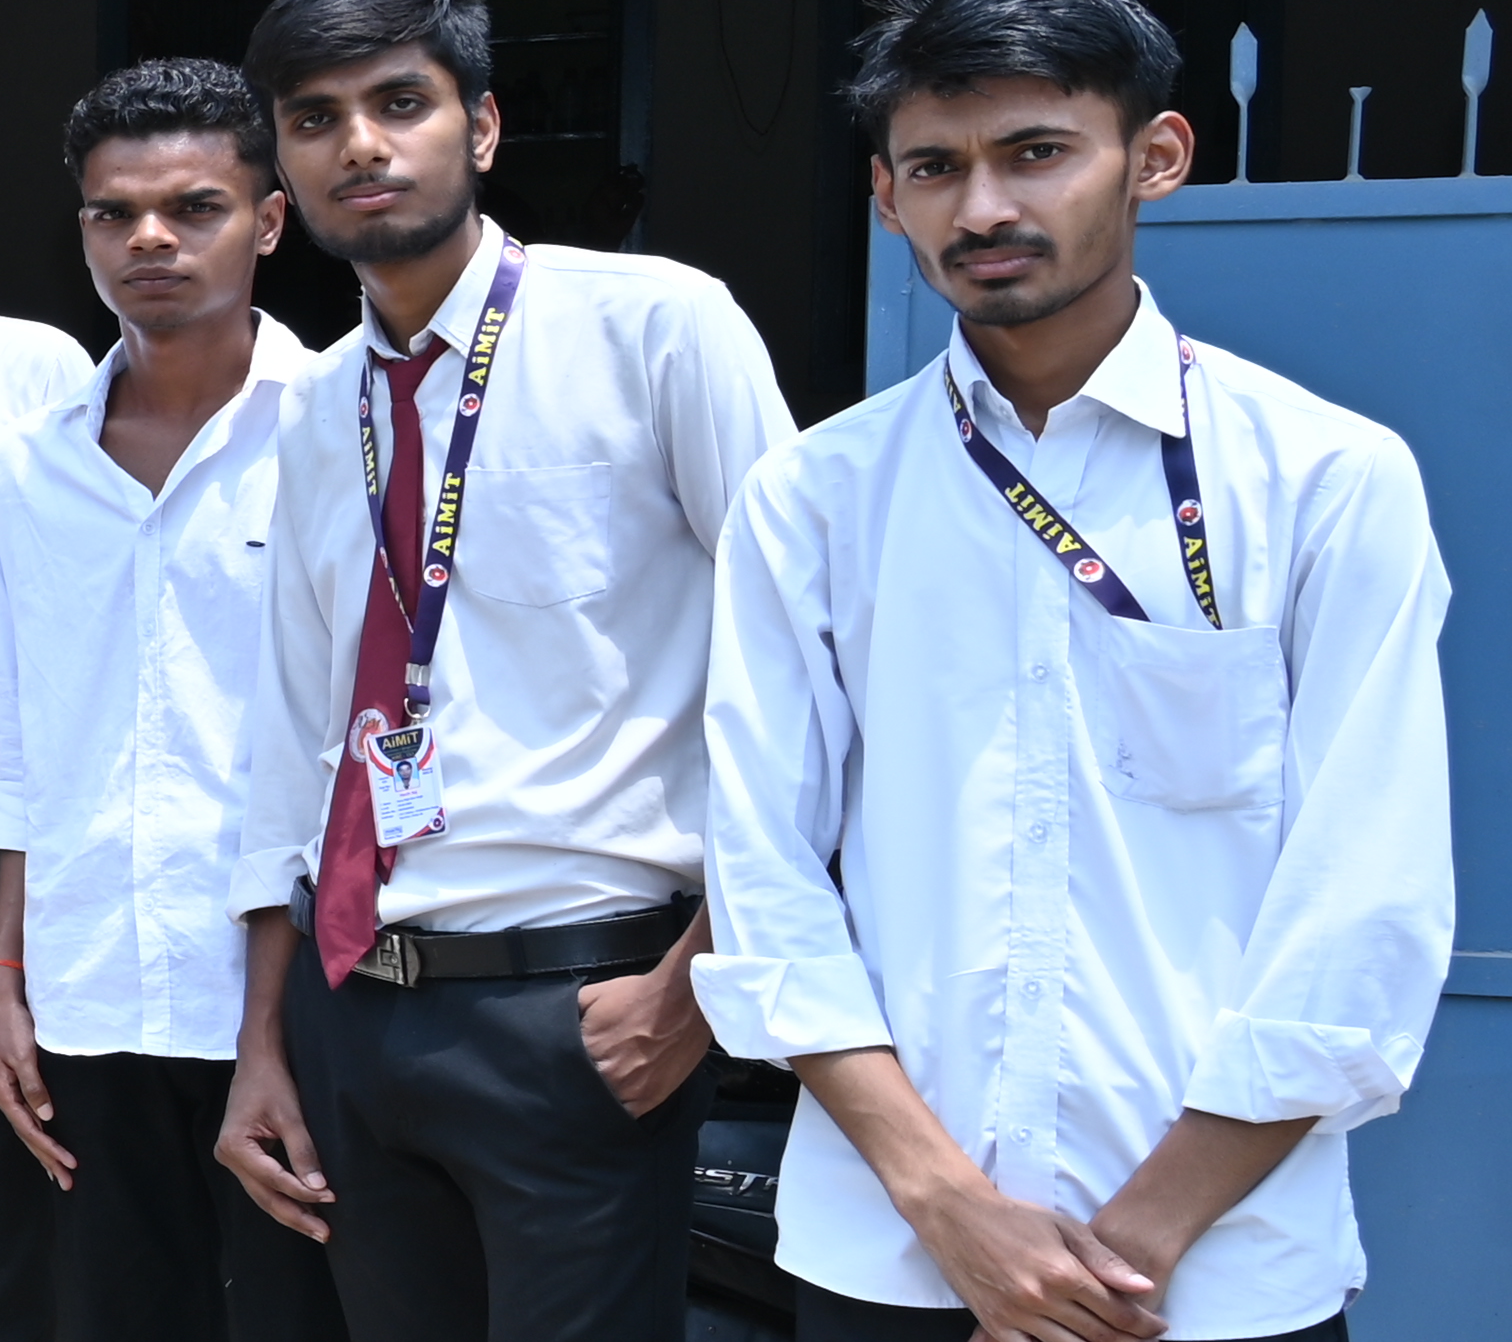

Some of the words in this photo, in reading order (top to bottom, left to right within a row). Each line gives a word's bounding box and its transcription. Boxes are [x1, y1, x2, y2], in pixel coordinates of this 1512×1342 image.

[467, 306, 508, 388] AiMiT
[431, 471, 463, 558] AiMiT
[1004, 481, 1083, 555] AiMiT
[381, 730, 420, 751] AiMiT
